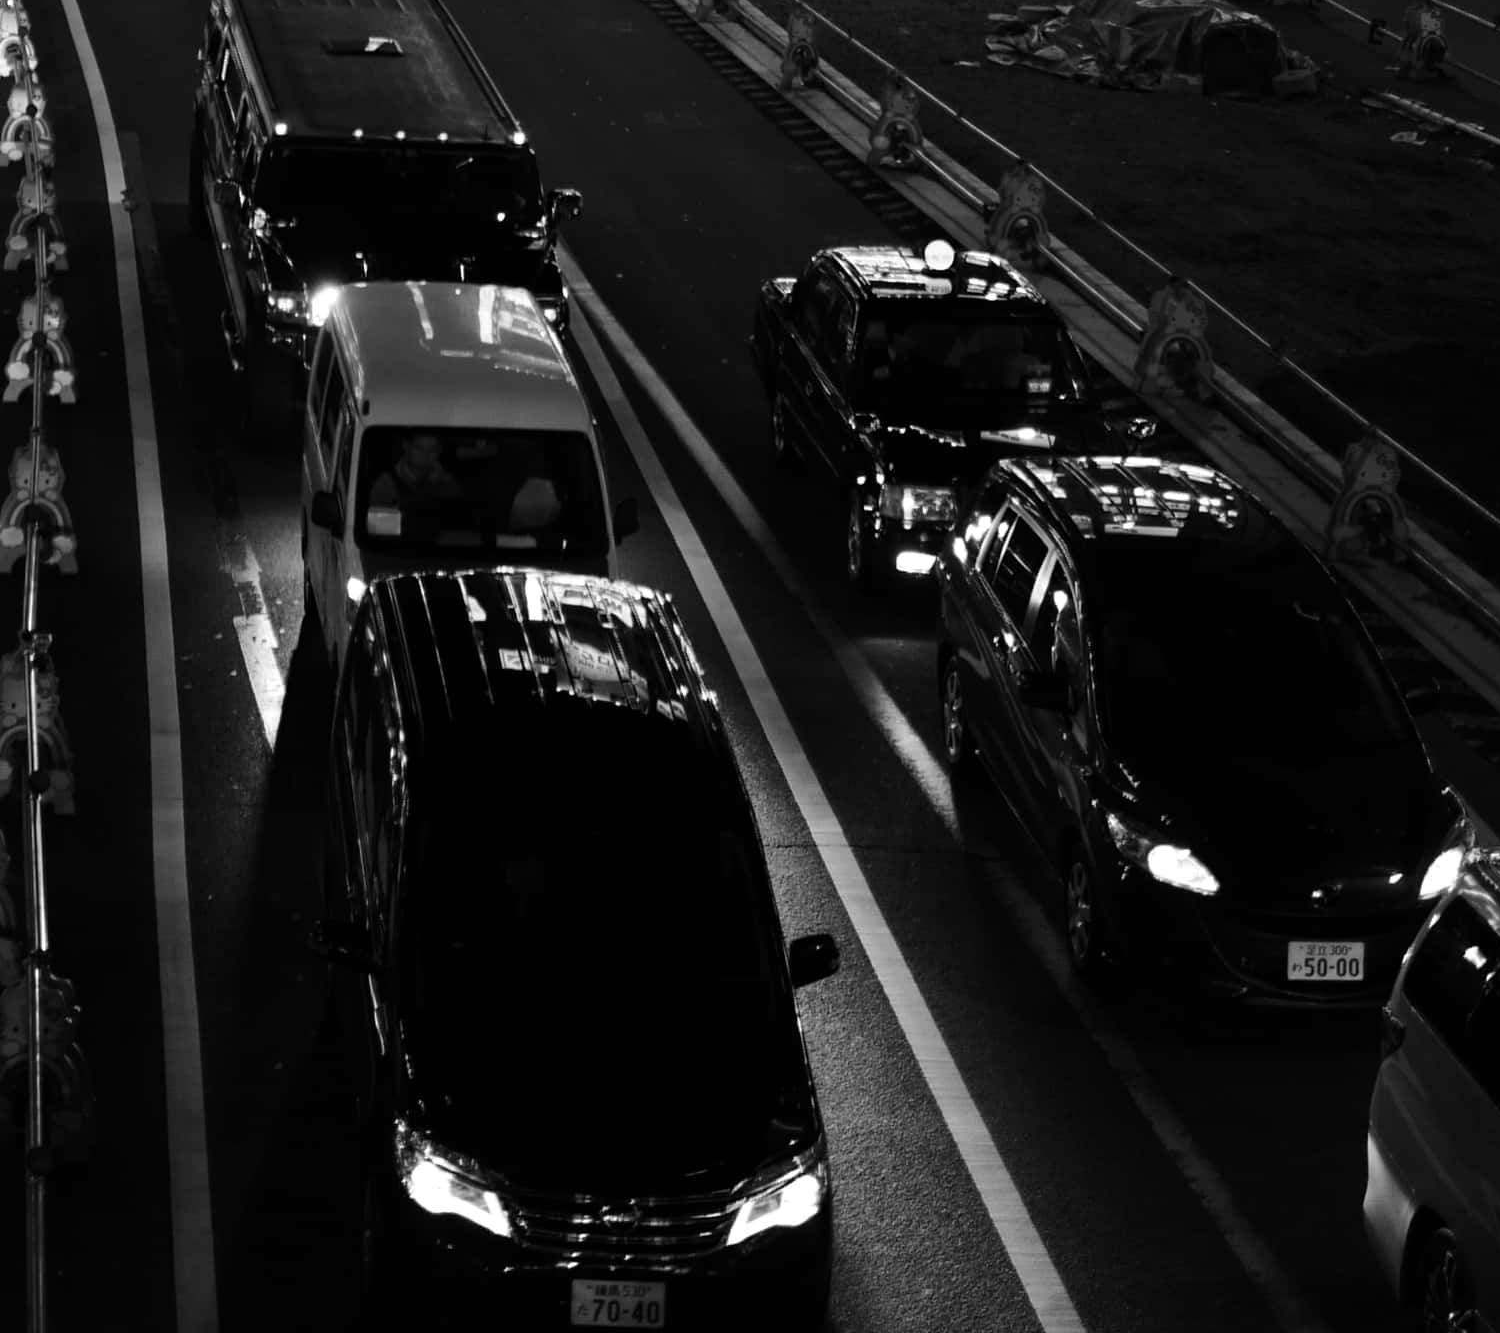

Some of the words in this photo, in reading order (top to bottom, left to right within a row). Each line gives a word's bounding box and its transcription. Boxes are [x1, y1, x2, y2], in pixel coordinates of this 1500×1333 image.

[1328, 945, 1349, 956] 300
[1304, 958, 1360, 977] 50-00
[592, 1300, 661, 1324] 70-40
